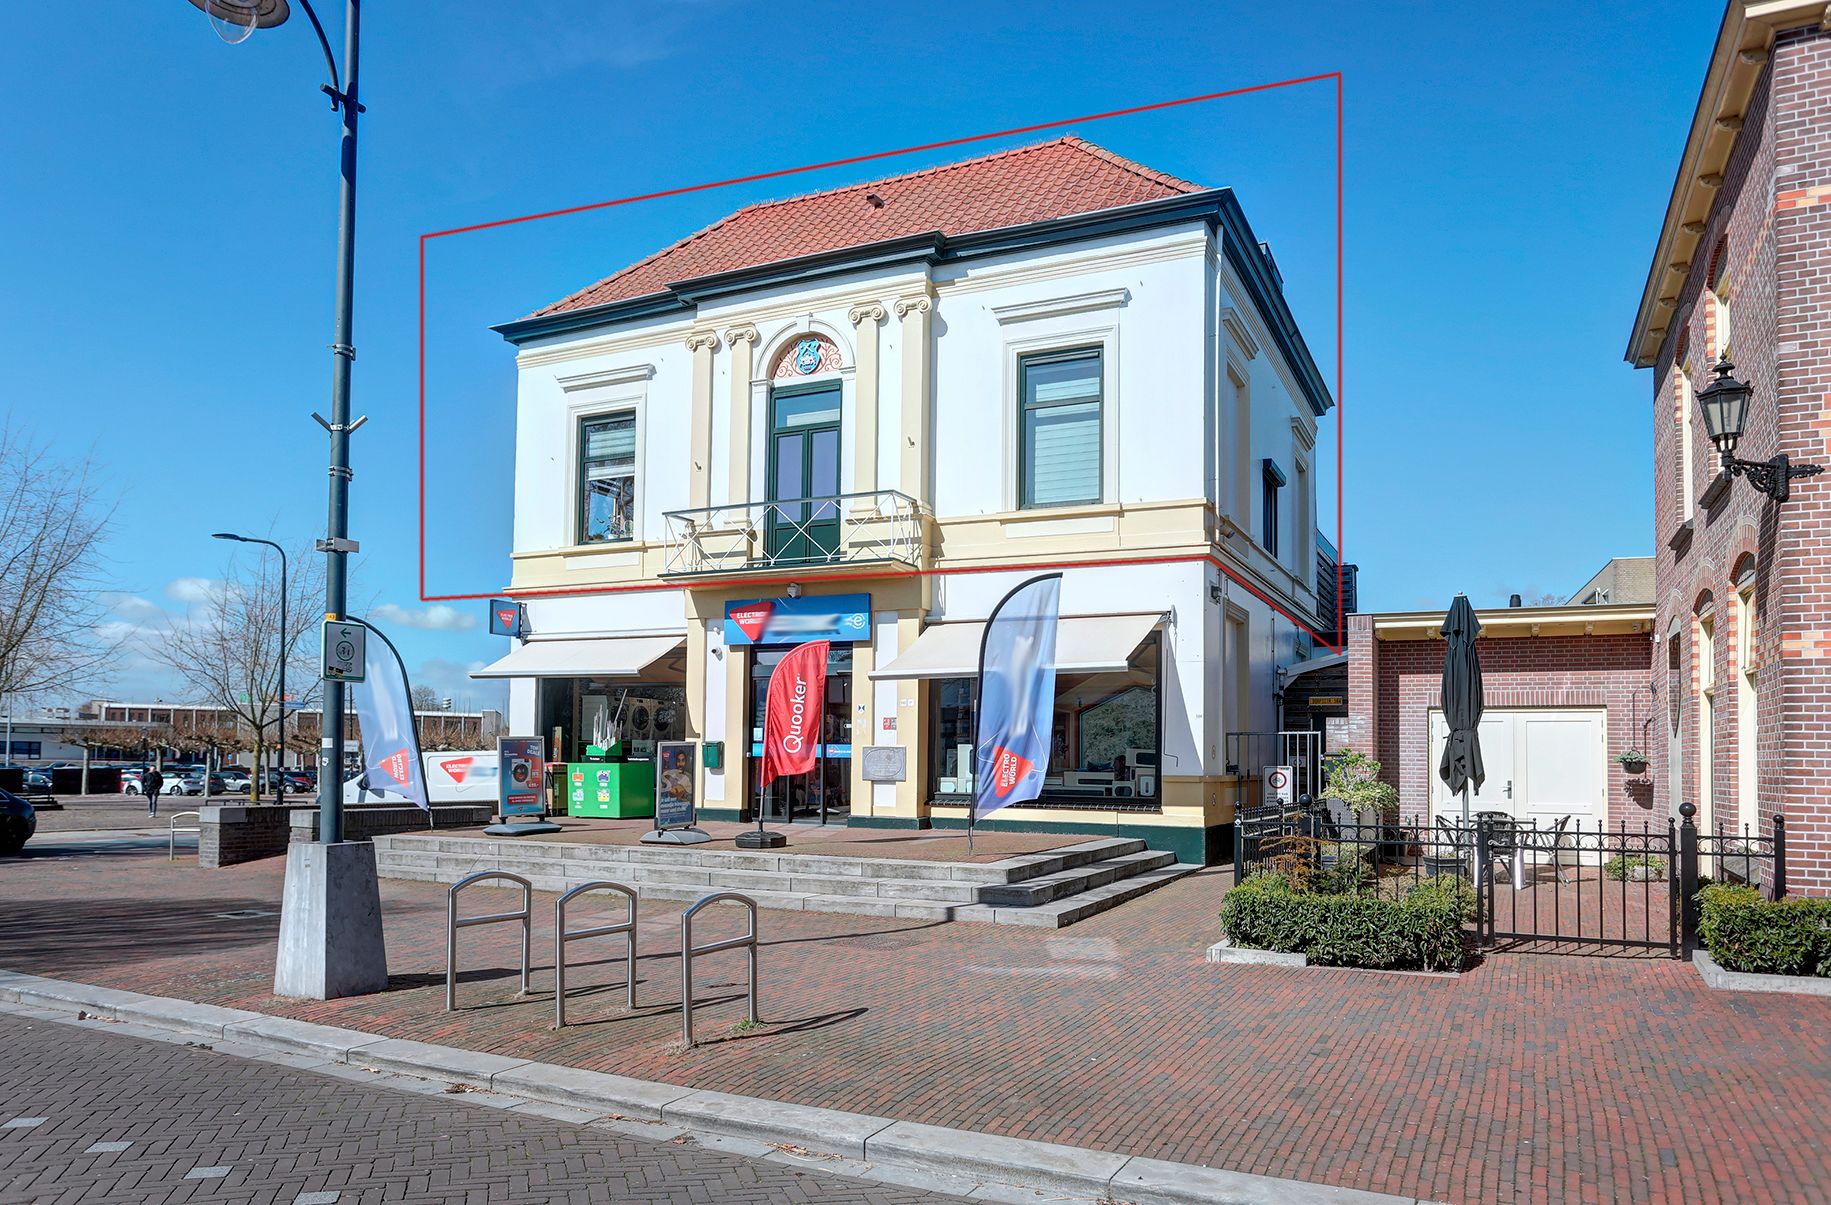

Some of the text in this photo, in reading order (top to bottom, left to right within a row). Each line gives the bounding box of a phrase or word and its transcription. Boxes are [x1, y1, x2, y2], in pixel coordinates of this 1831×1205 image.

[783, 676, 807, 754] Quooker
[1000, 753, 1010, 787] ELECTRO
[1009, 756, 1017, 785] WORLD
